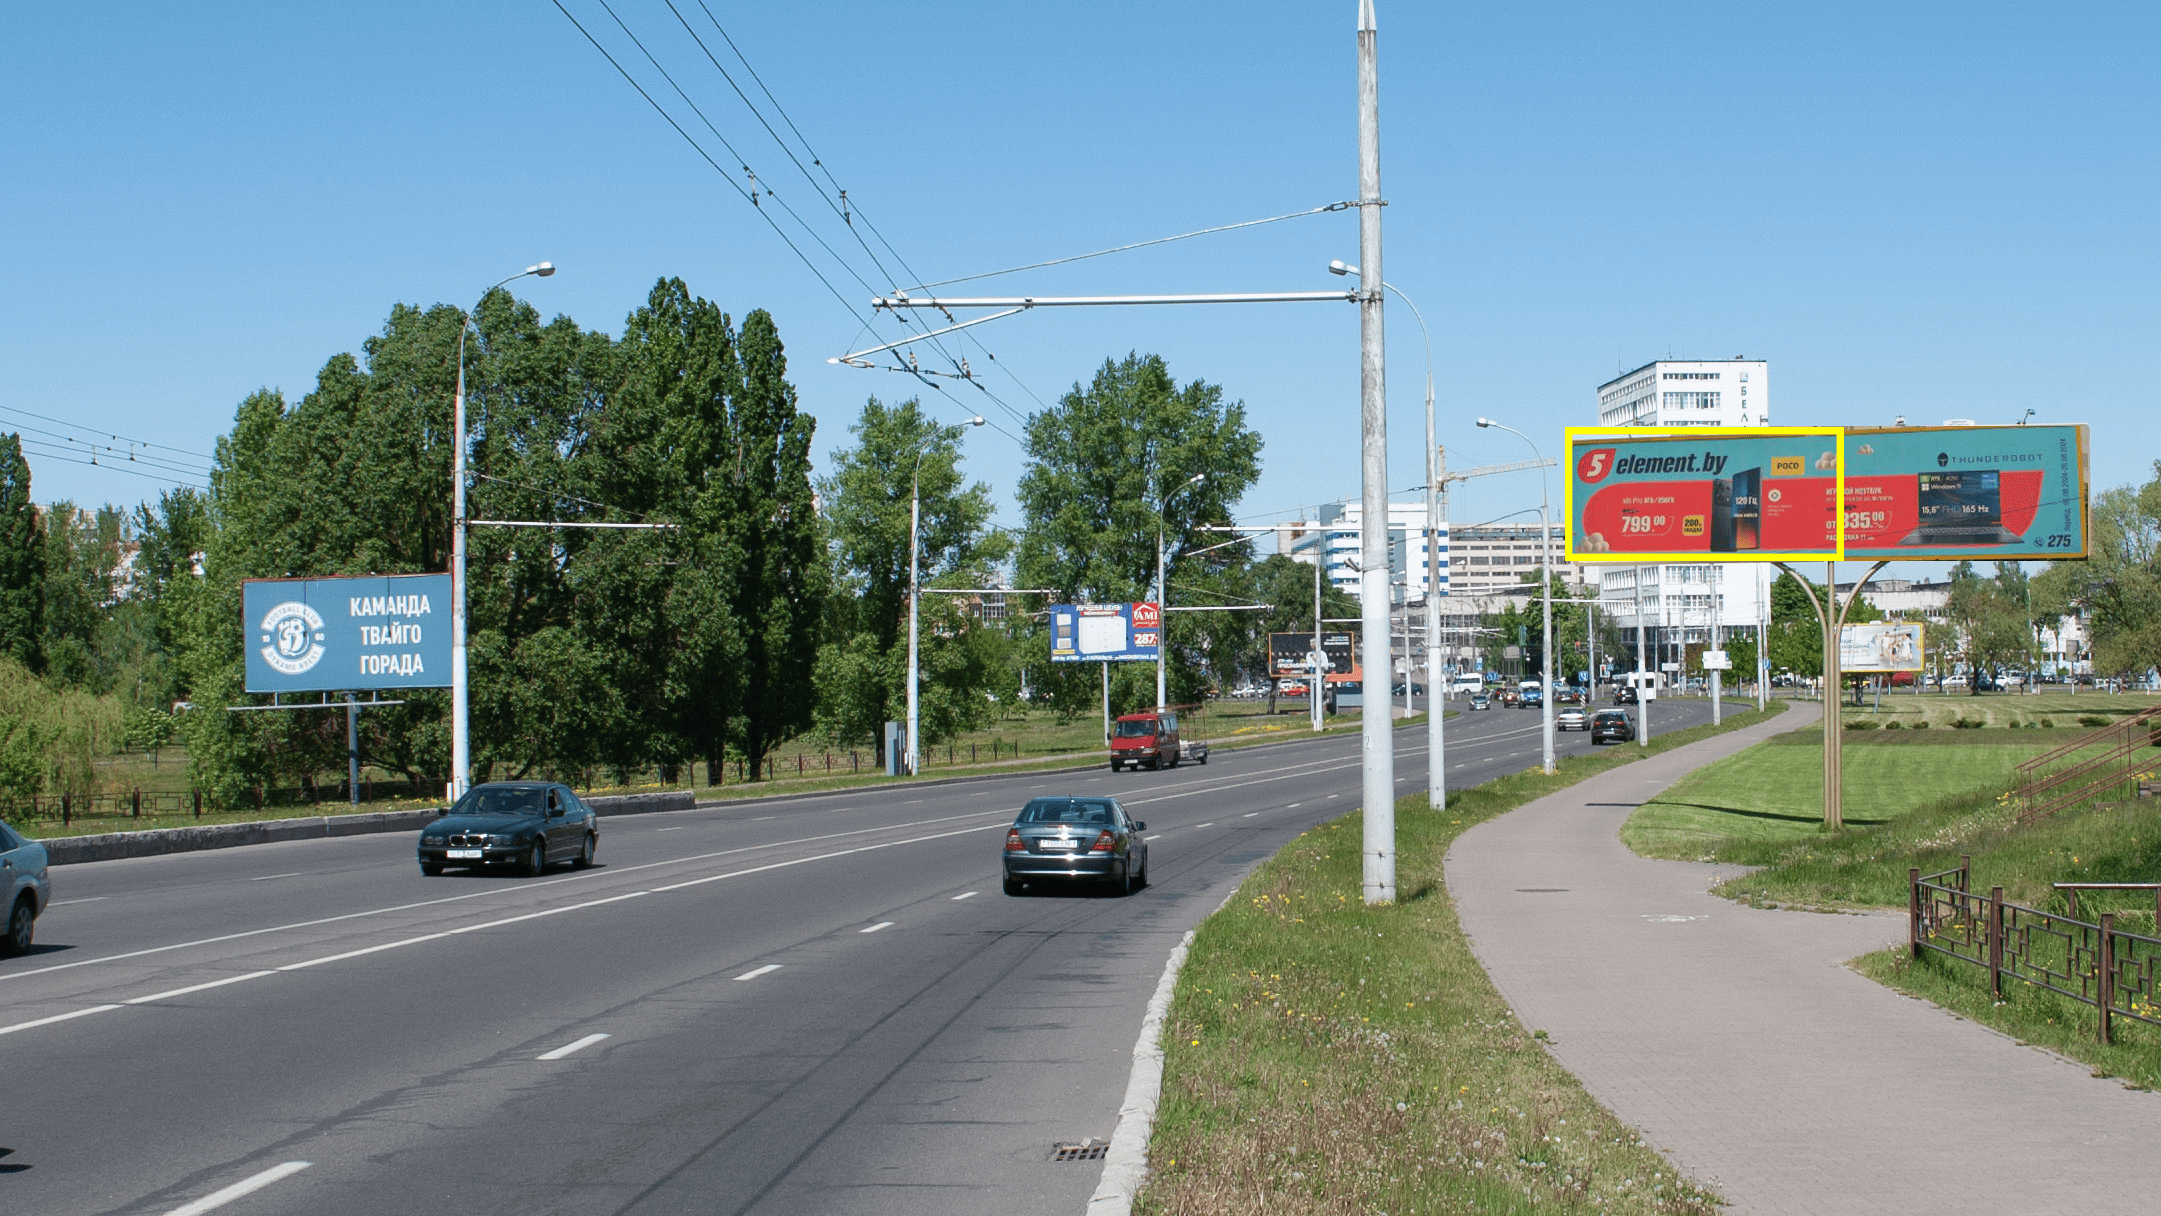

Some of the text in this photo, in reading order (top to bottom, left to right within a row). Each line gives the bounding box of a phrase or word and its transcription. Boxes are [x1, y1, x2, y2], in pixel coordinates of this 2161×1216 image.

[1952, 452, 2043, 463] THUNDEROBOT
[1586, 452, 1728, 478] 5 element.by
[1776, 462, 1800, 470] POCO
[1735, 496, 1748, 505] 120
[1962, 505, 1976, 513] 165
[1978, 505, 1990, 513] Hz
[2047, 534, 2072, 548] 275
[350, 594, 432, 618] КАМАНДА
[360, 621, 422, 646] ТВАЙГО
[359, 653, 424, 677] ГОРАДА
